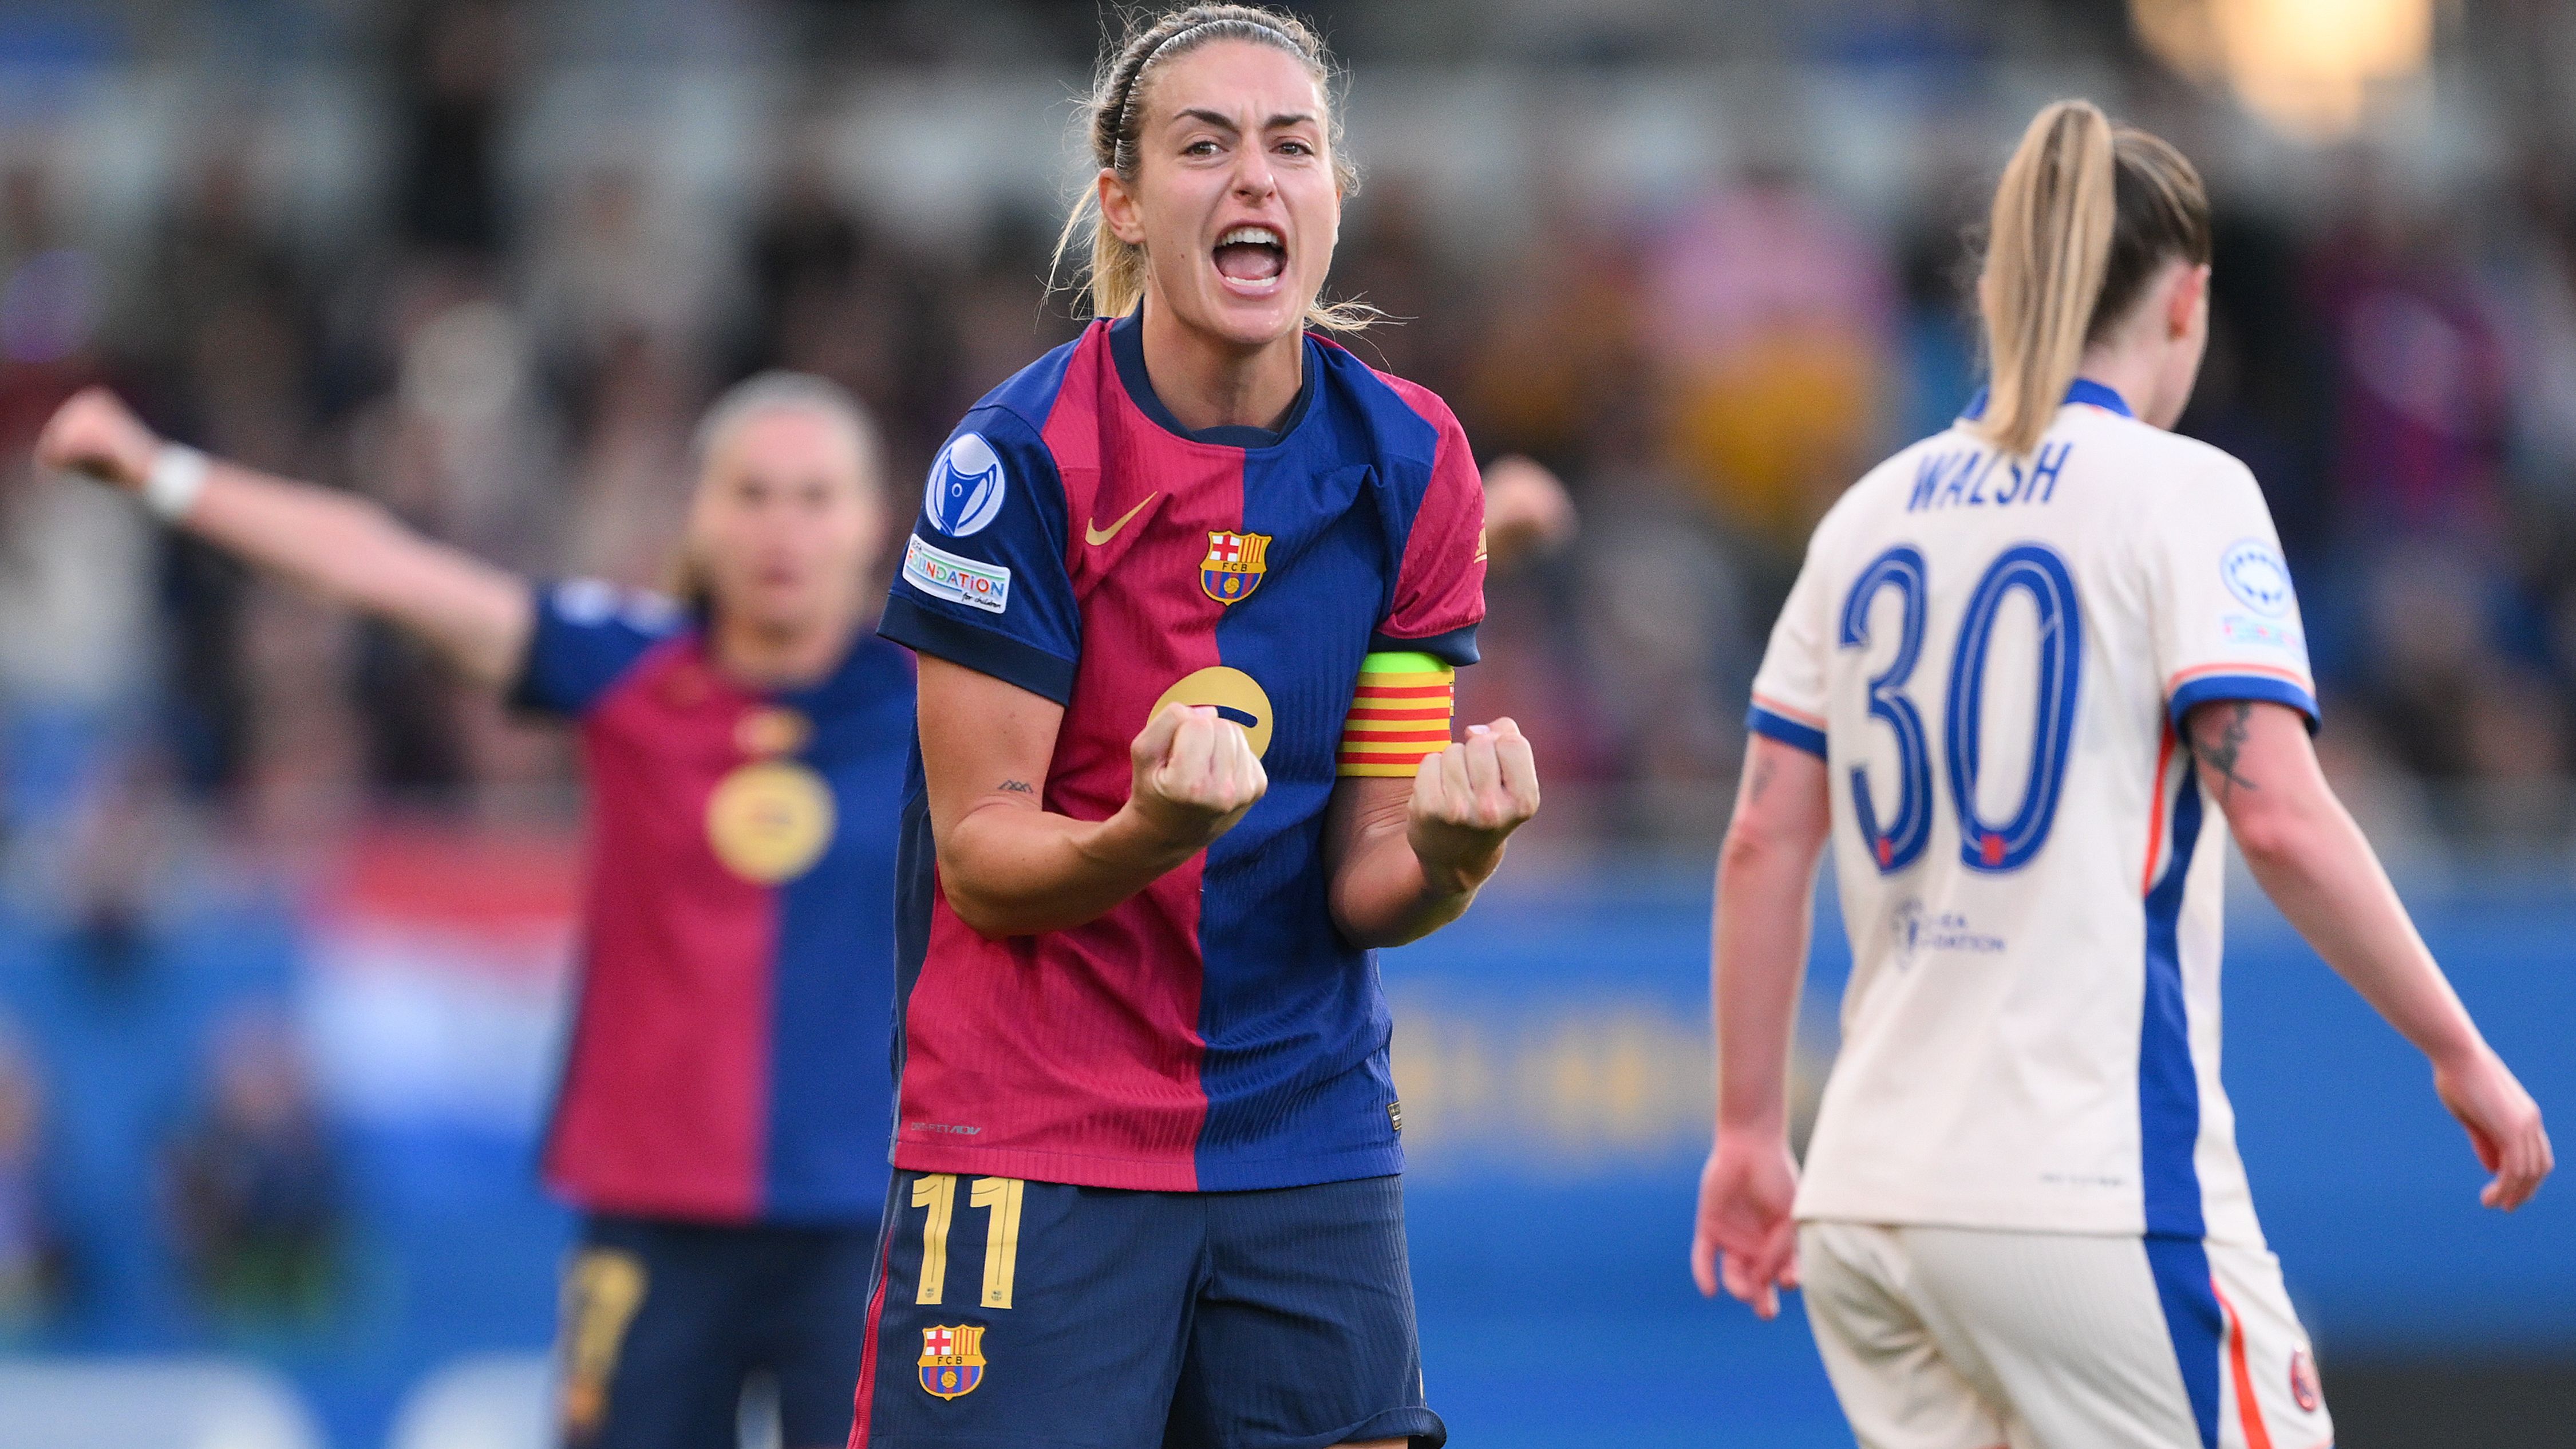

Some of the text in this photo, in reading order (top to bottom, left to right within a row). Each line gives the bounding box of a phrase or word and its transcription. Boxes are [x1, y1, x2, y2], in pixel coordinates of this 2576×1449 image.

[1907, 442, 2073, 512] WALSH
[1839, 540, 2082, 874] 30
[911, 1173, 1025, 1309] 11
